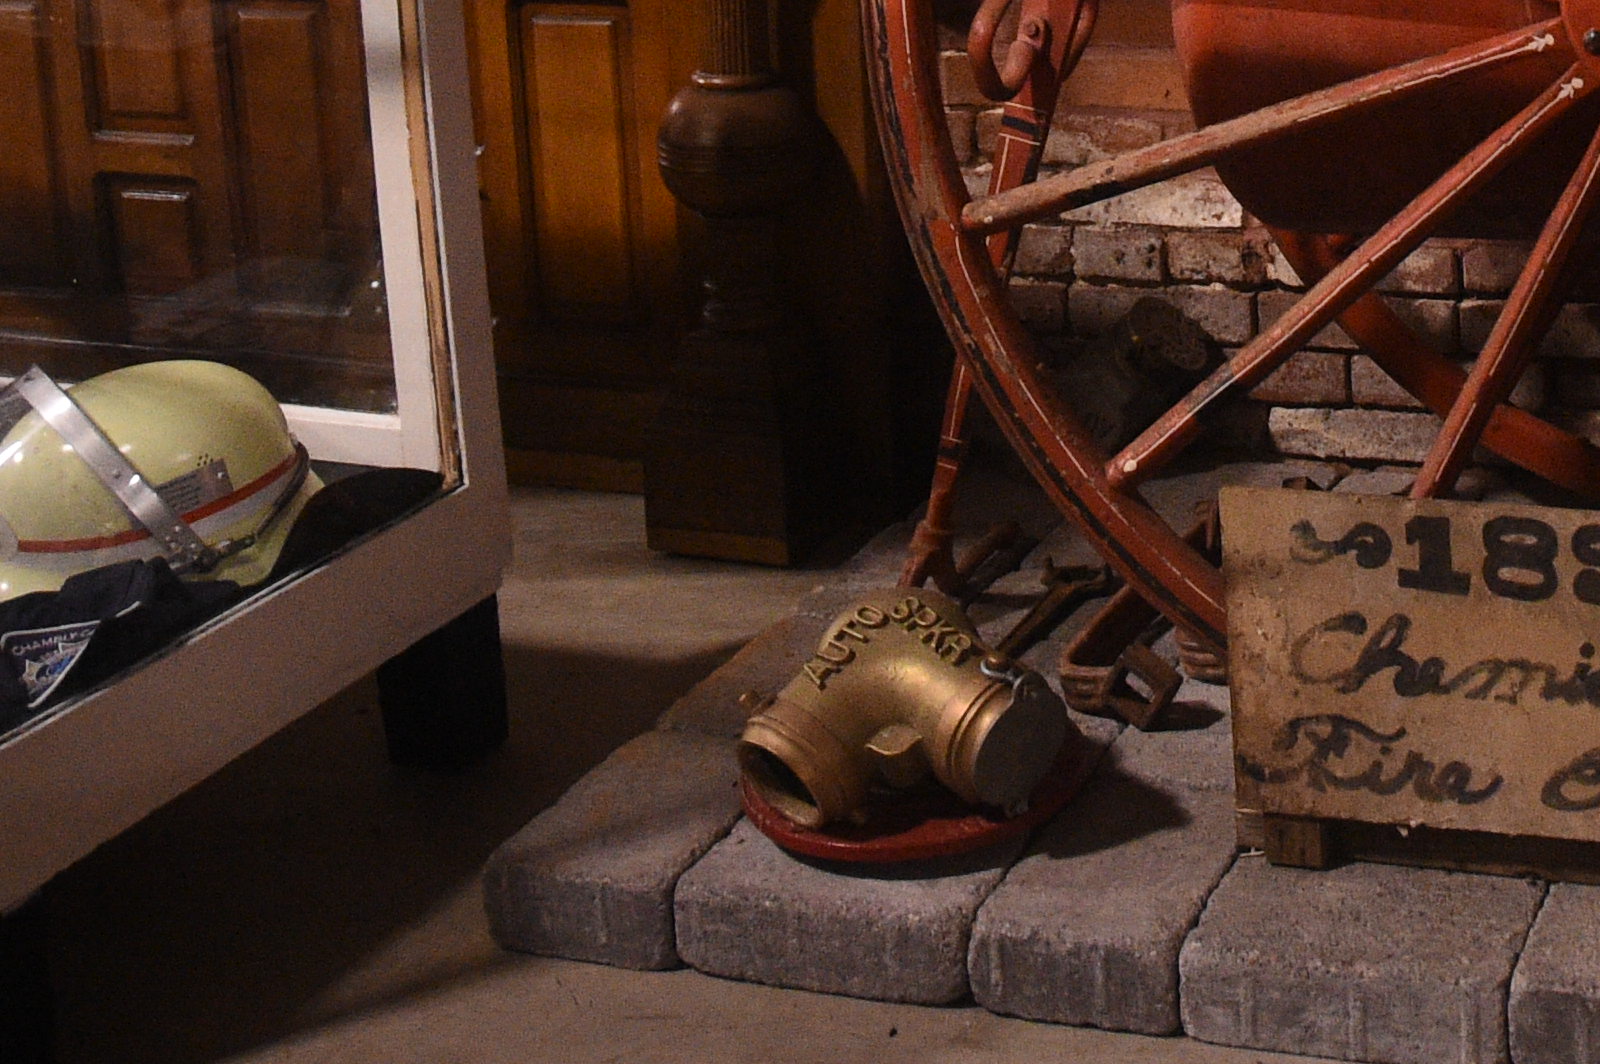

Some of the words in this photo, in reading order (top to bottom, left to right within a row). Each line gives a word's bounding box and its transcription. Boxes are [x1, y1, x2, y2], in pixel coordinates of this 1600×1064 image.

[803, 604, 886, 686] AUTO
[891, 596, 972, 664] SPKR
[1236, 714, 1504, 804] Fire
